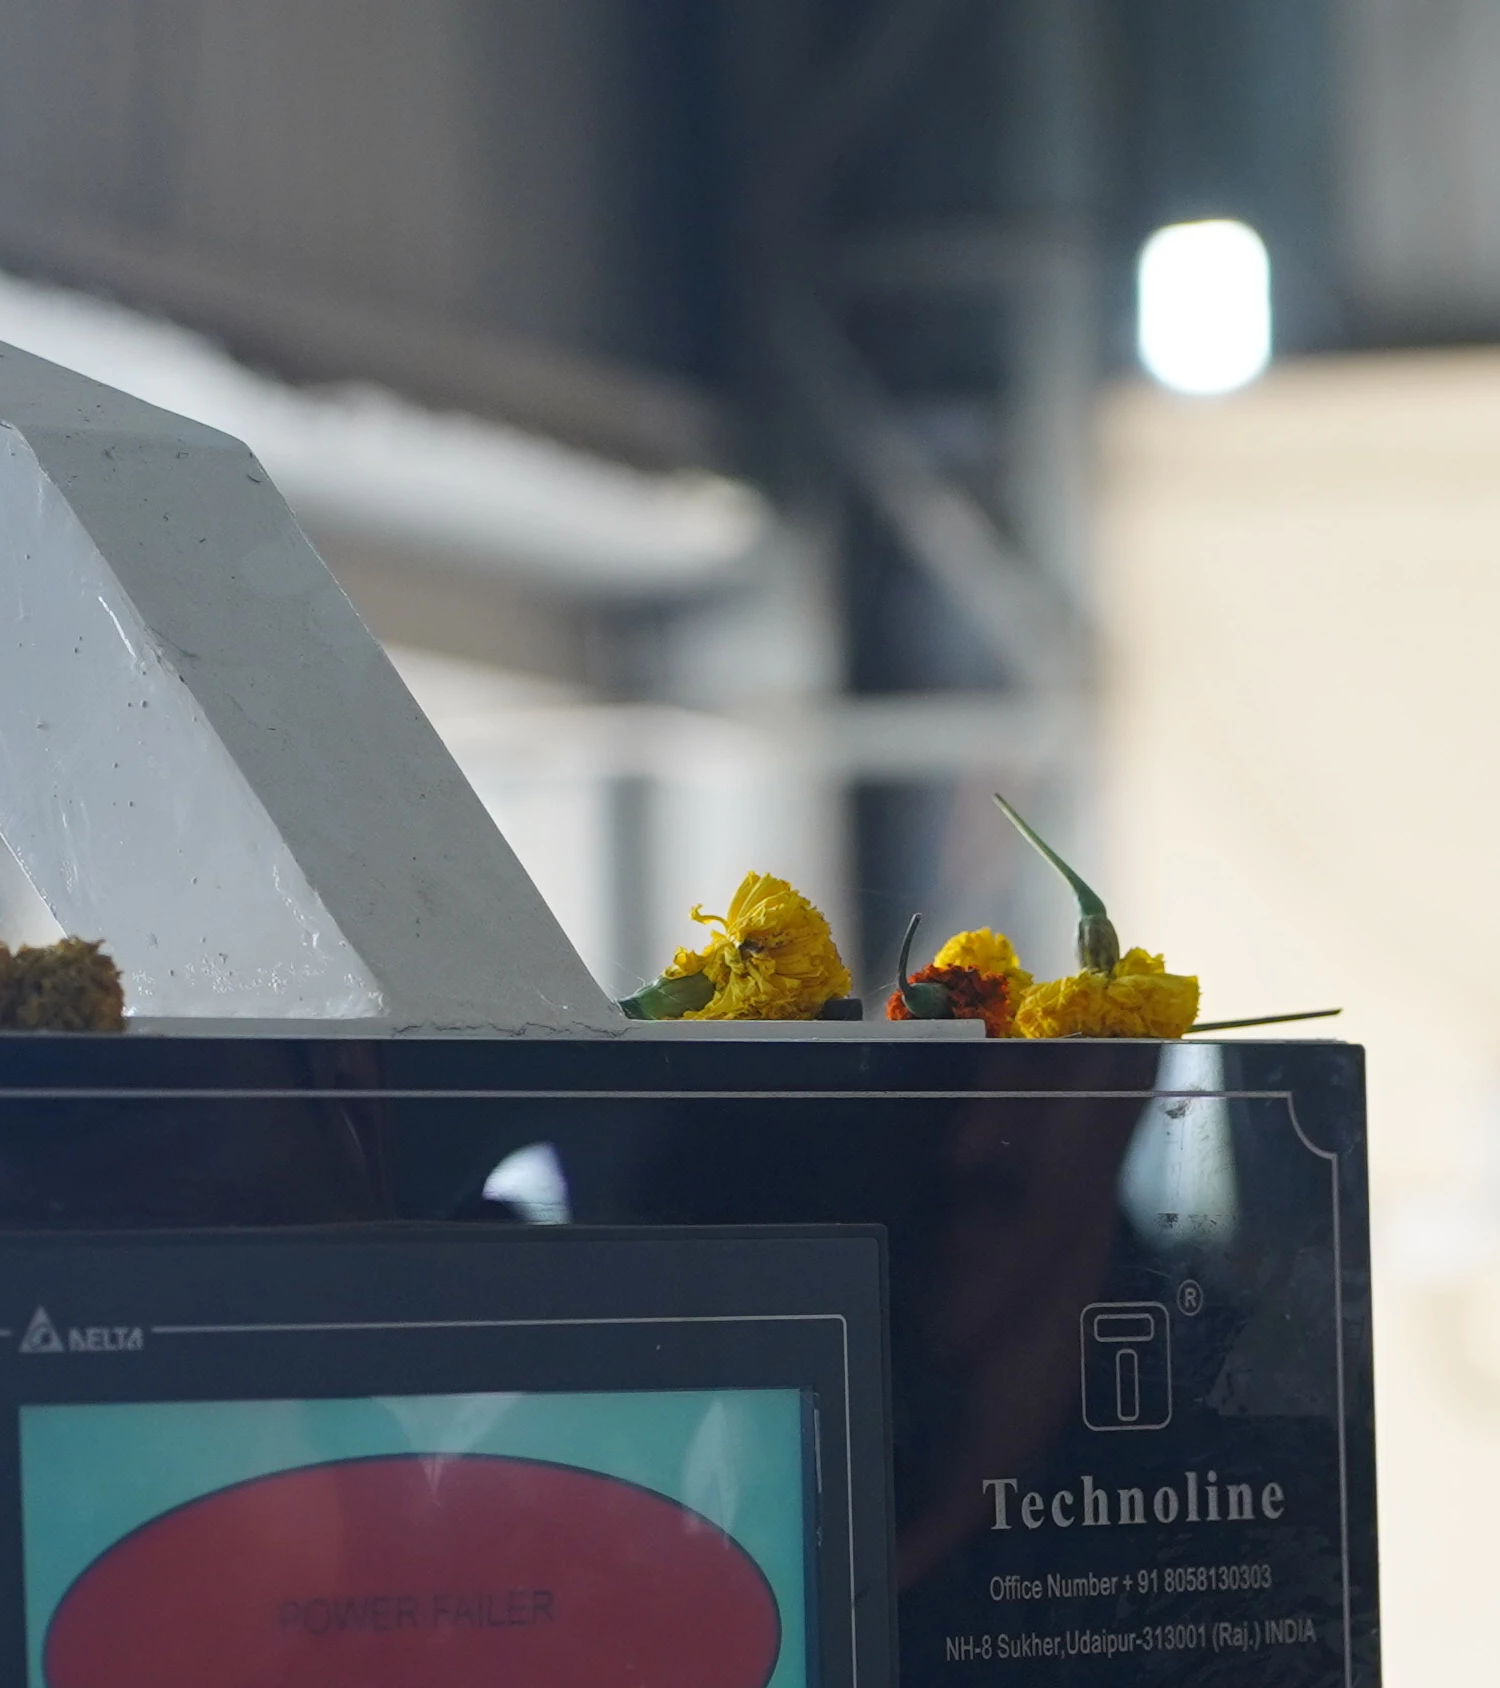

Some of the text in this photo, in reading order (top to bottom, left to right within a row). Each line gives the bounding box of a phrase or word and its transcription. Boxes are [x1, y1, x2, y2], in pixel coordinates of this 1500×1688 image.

[982, 1470, 1285, 1531] Technoline
[989, 1575, 1043, 1601] Office
[1047, 1572, 1118, 1598] Number
[1164, 1564, 1272, 1593] 8058130303
[277, 1589, 556, 1634] POWER FAILER
[945, 1635, 993, 1662] NH-8
[1212, 1622, 1261, 1653] (Raj.)
[1264, 1619, 1317, 1646] INDIA
